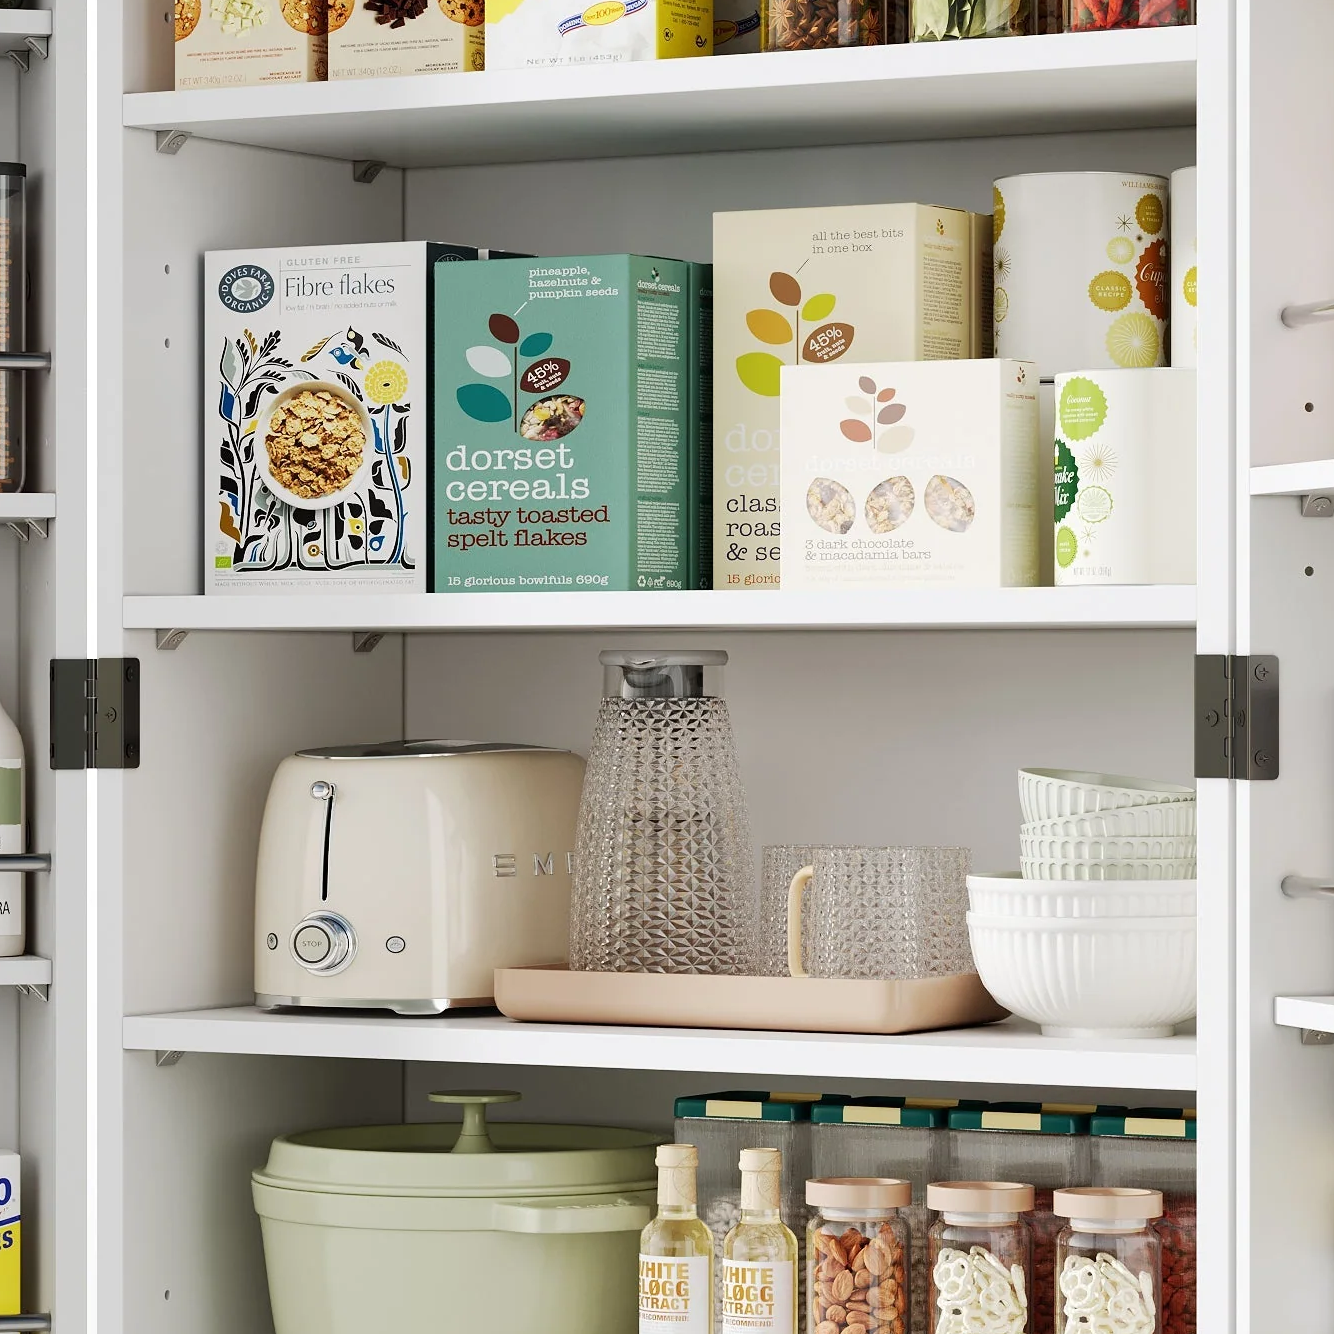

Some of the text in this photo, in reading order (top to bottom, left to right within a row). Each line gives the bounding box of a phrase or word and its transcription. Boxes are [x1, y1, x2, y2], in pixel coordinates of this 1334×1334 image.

[812, 229, 904, 241] all the best bits
[812, 245, 824, 254] in
[852, 243, 873, 252] box
[287, 259, 329, 267] GLUTEN
[221, 267, 271, 292] DOVES FARM
[528, 266, 591, 279] pineapple,
[285, 273, 395, 297] Fibre flakes
[528, 276, 602, 287] hazelnuts &
[637, 280, 680, 293] dorset cereals
[528, 287, 619, 301] pumpkin seeds
[224, 294, 269, 311] ORGANIC
[809, 326, 843, 352] 45%
[527, 361, 560, 384] 45%
[446, 443, 574, 471] dorset
[446, 473, 590, 502] cereals
[447, 506, 610, 527] tasty toasted
[447, 529, 587, 551] spelt flakes
[805, 539, 914, 549] 3 dark chocolate
[820, 550, 899, 561] macadamia
[902, 549, 931, 560] bars
[448, 575, 609, 588] 15 glorious bowlfuls 690g
